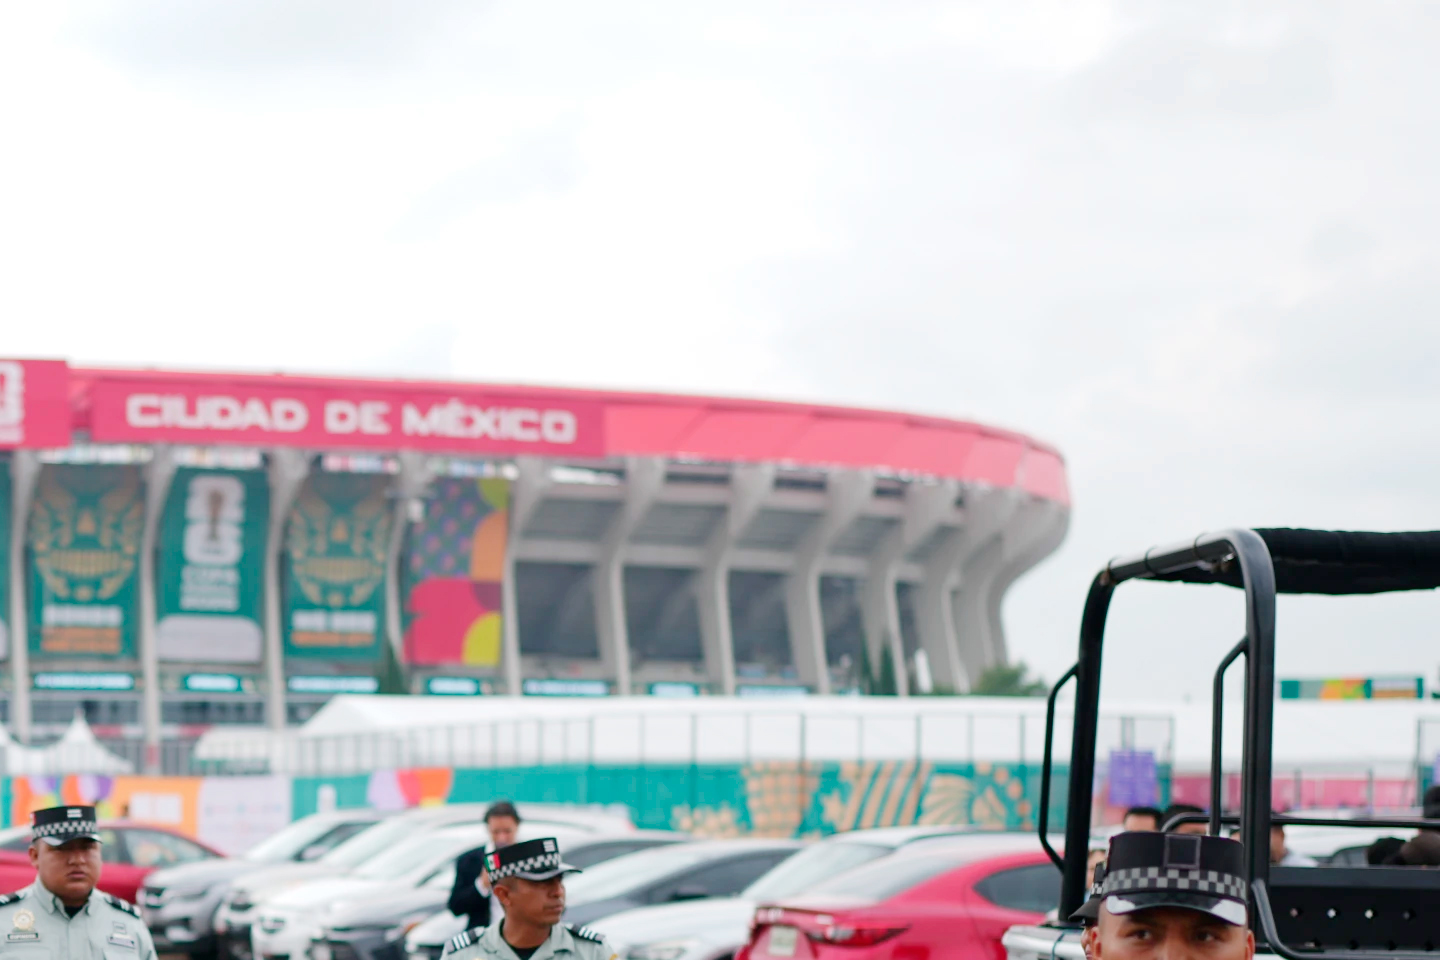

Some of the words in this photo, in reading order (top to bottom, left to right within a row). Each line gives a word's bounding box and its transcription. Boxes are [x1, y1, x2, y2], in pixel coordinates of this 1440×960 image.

[126, 393, 309, 432] CIUDAD
[324, 399, 391, 435] DE
[401, 397, 578, 445] MÉXICO
